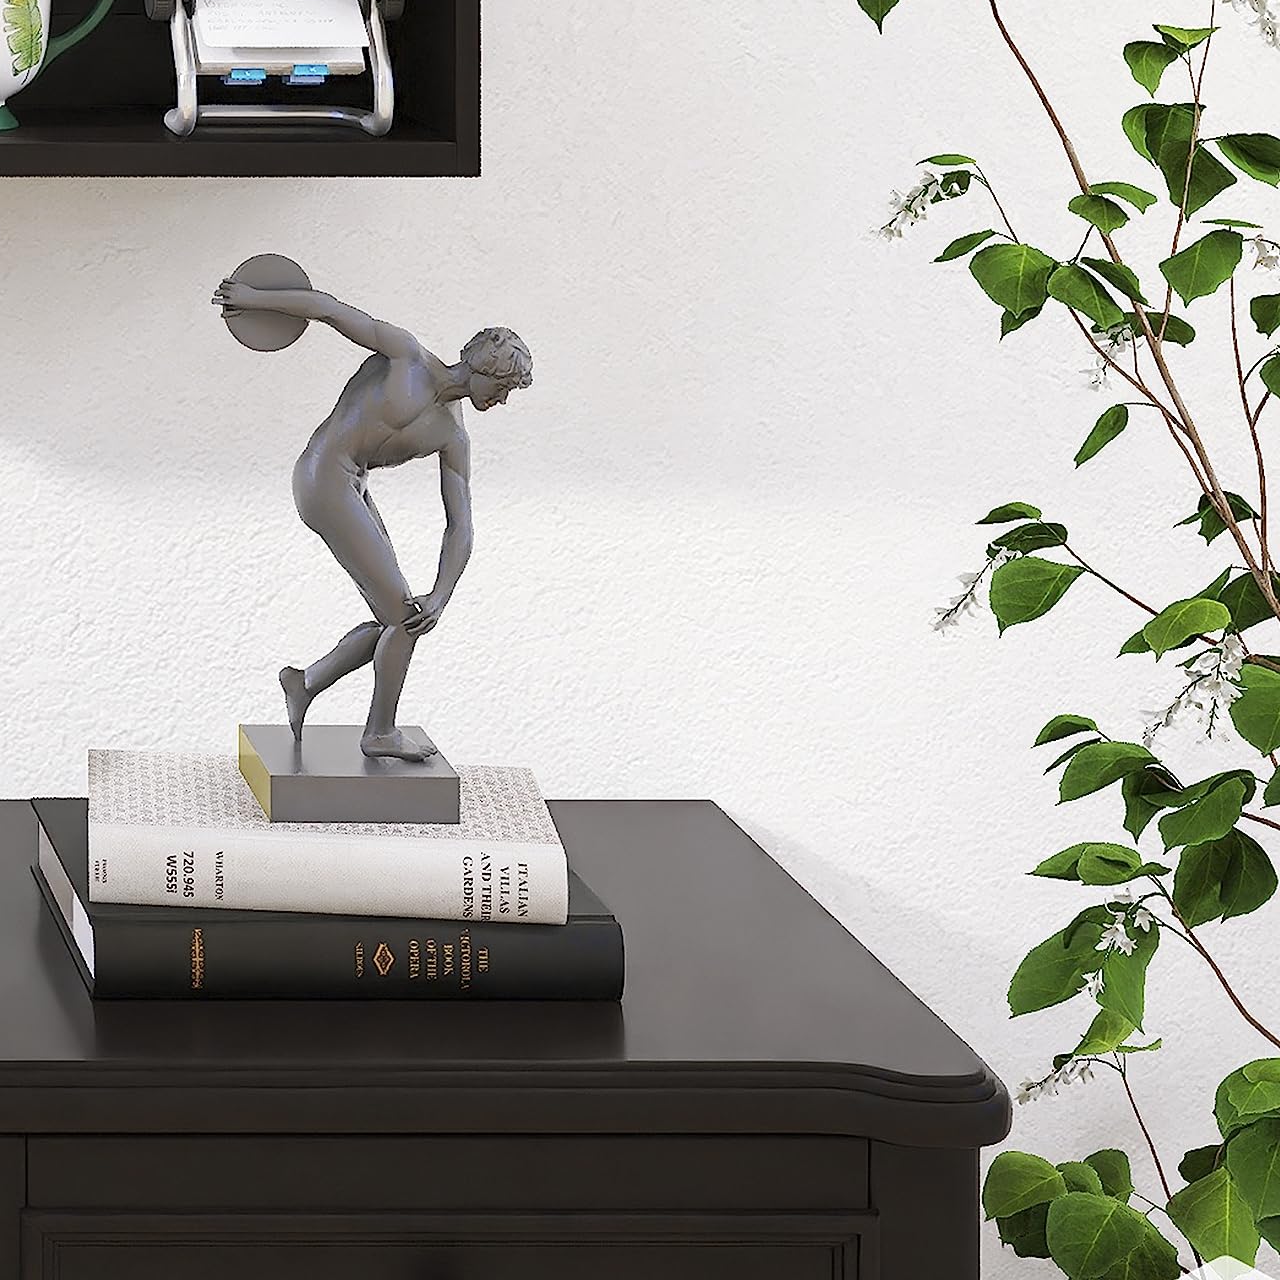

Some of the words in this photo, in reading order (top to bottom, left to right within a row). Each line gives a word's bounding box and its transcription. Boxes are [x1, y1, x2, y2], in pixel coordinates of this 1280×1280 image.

[183, 850, 195, 898] 720.945
[214, 850, 224, 901] WHARTON
[463, 856, 474, 918] GARDENS
[480, 851, 492, 882] AND
[480, 884, 492, 921] THEIR
[499, 866, 510, 914] VILLAS
[517, 862, 529, 917] ITALIAN
[409, 939, 420, 980] OPERA
[443, 943, 454, 976] BOOK
[478, 946, 489, 973] THE
